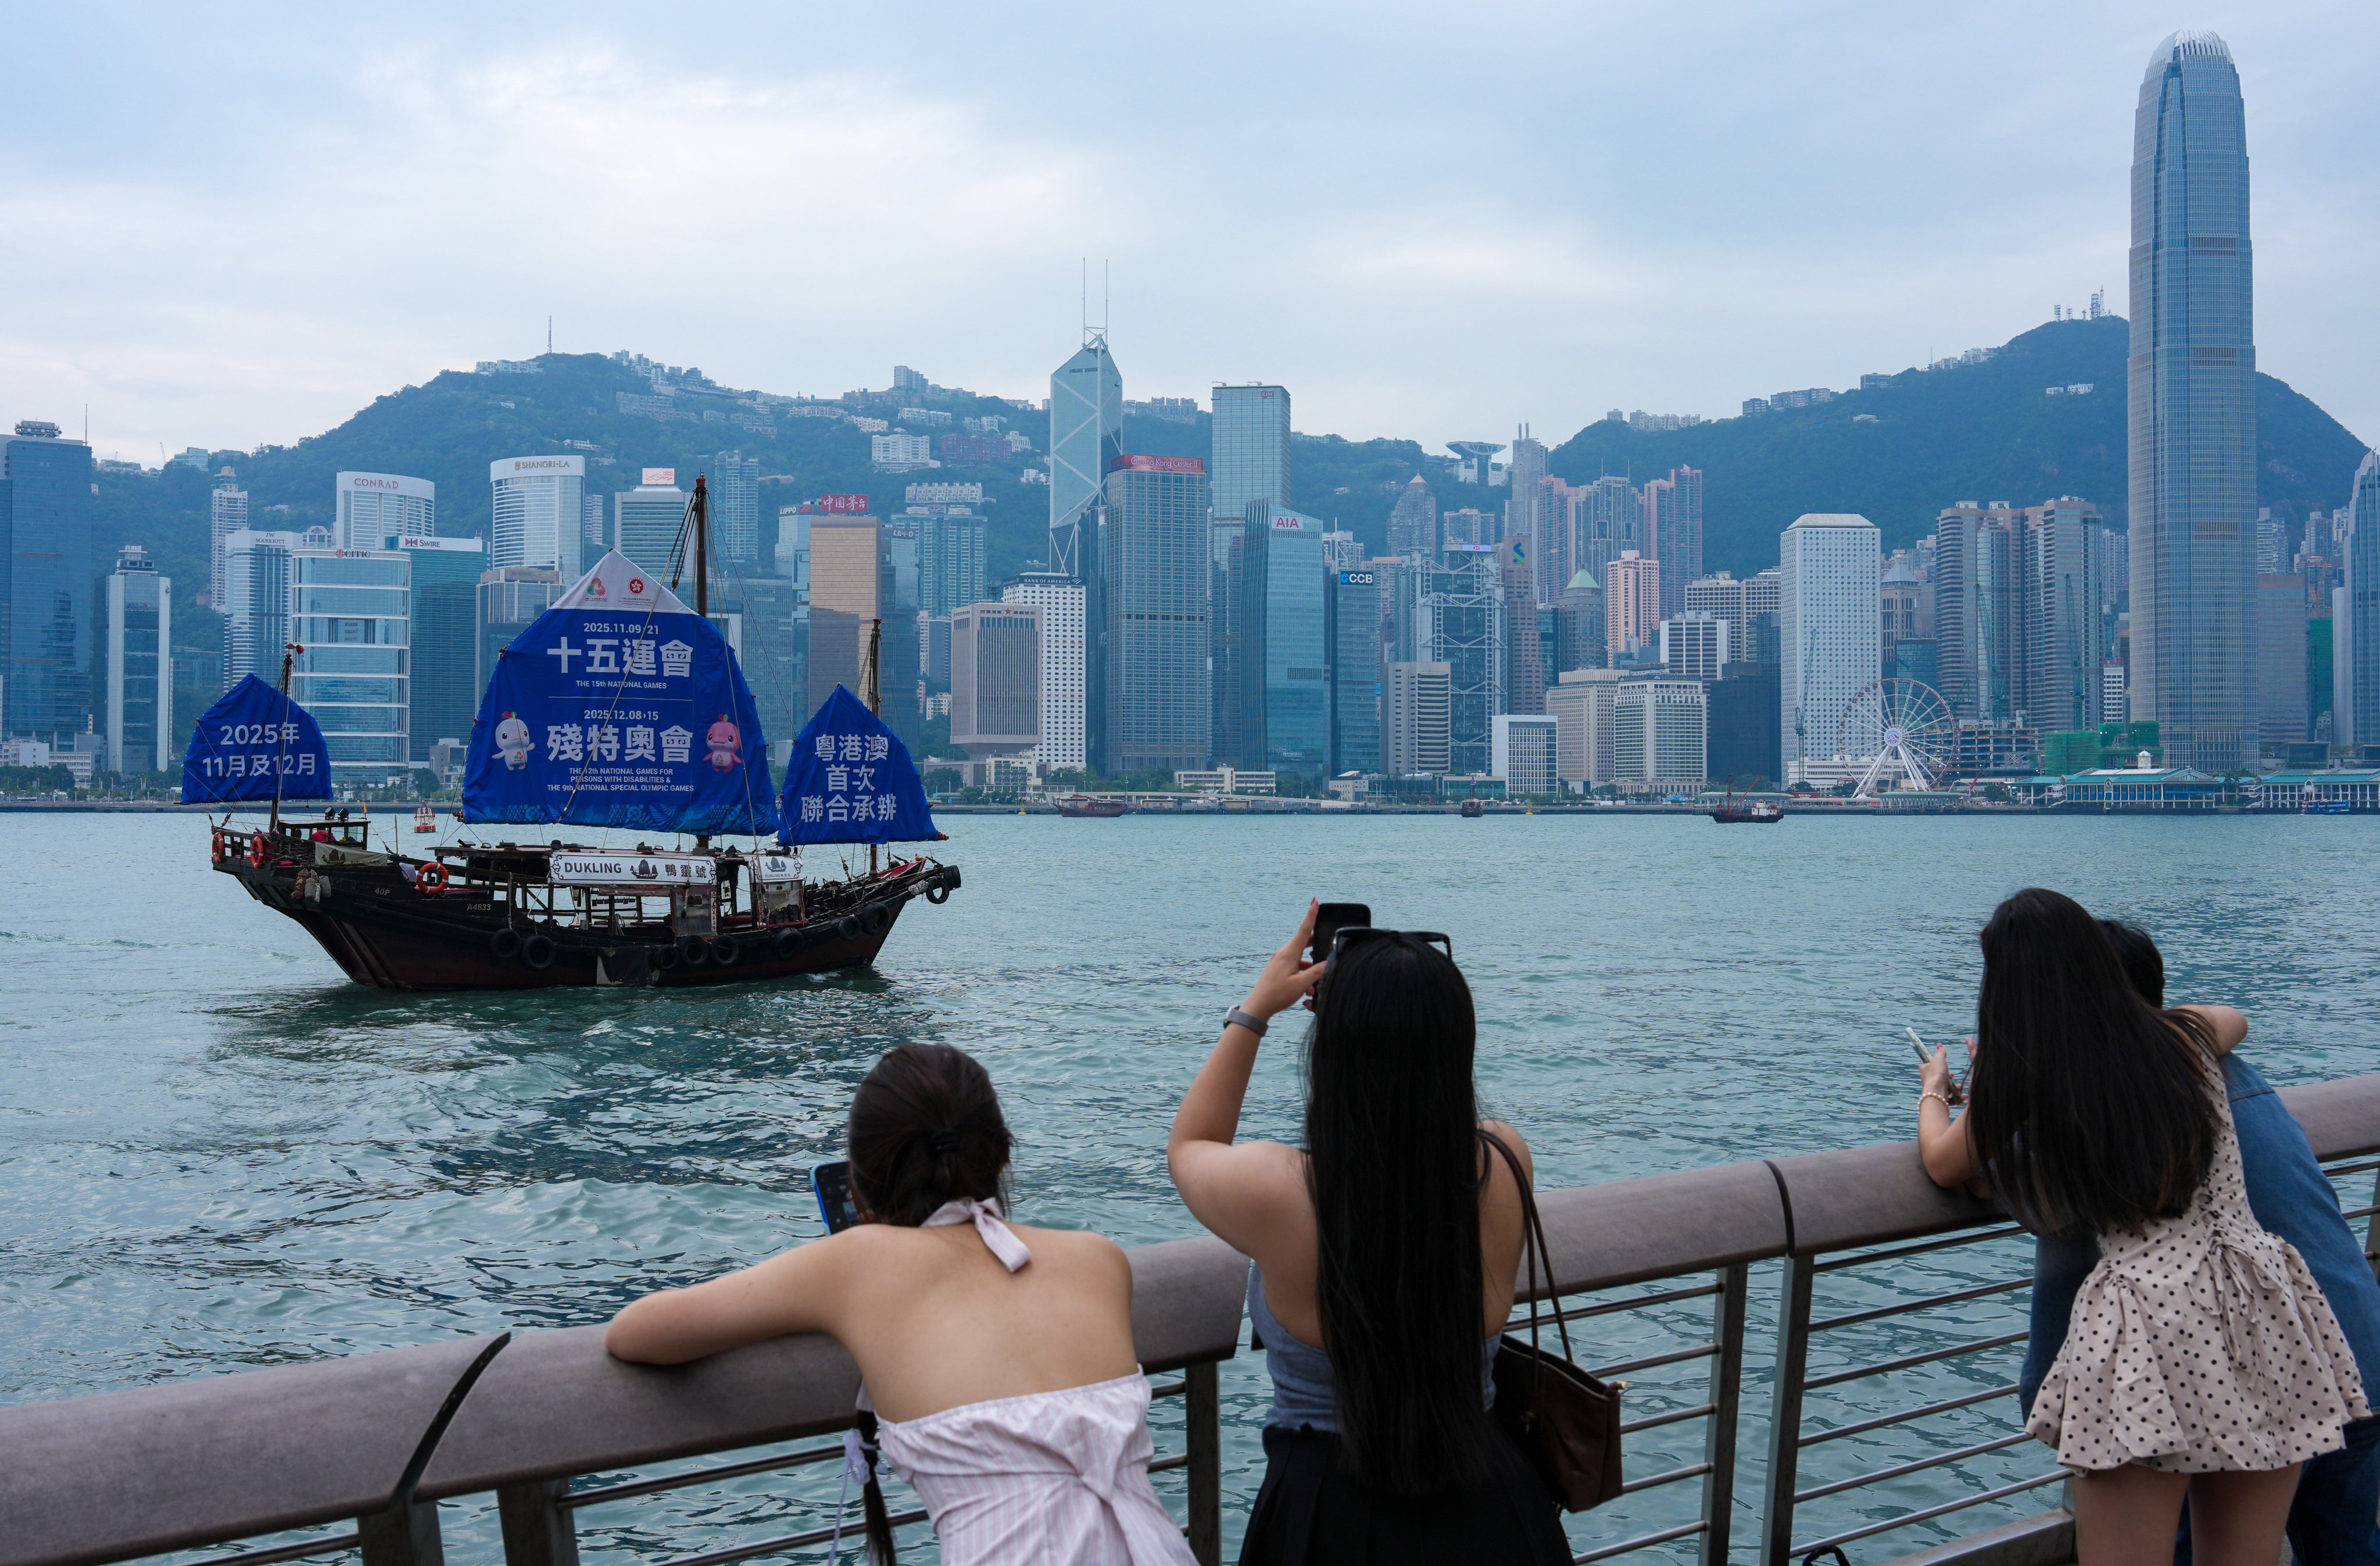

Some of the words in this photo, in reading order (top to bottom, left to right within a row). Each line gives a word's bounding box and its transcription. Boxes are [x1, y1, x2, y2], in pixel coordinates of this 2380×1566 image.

[522, 460, 570, 469] SHANGRI-LA
[1130, 457, 1154, 468] Cheung
[1155, 458, 1172, 469] Kong
[1173, 459, 1193, 467] Center
[354, 478, 399, 488] CONRAD
[823, 495, 865, 512] 中国茅台
[779, 506, 797, 514] LIPPO
[1276, 517, 1300, 528] AIA
[345, 550, 370, 558] CITIC
[1348, 574, 1373, 583] CCB
[547, 637, 693, 677] 十五運會
[220, 721, 300, 745] 2025年
[547, 723, 694, 763] 殘特奧會
[202, 753, 315, 778] 11月及12月
[825, 764, 875, 792] 首次
[564, 862, 622, 873] DUKLING
[665, 864, 707, 878] 鴨靈號
[375, 888, 390, 896] 40P
